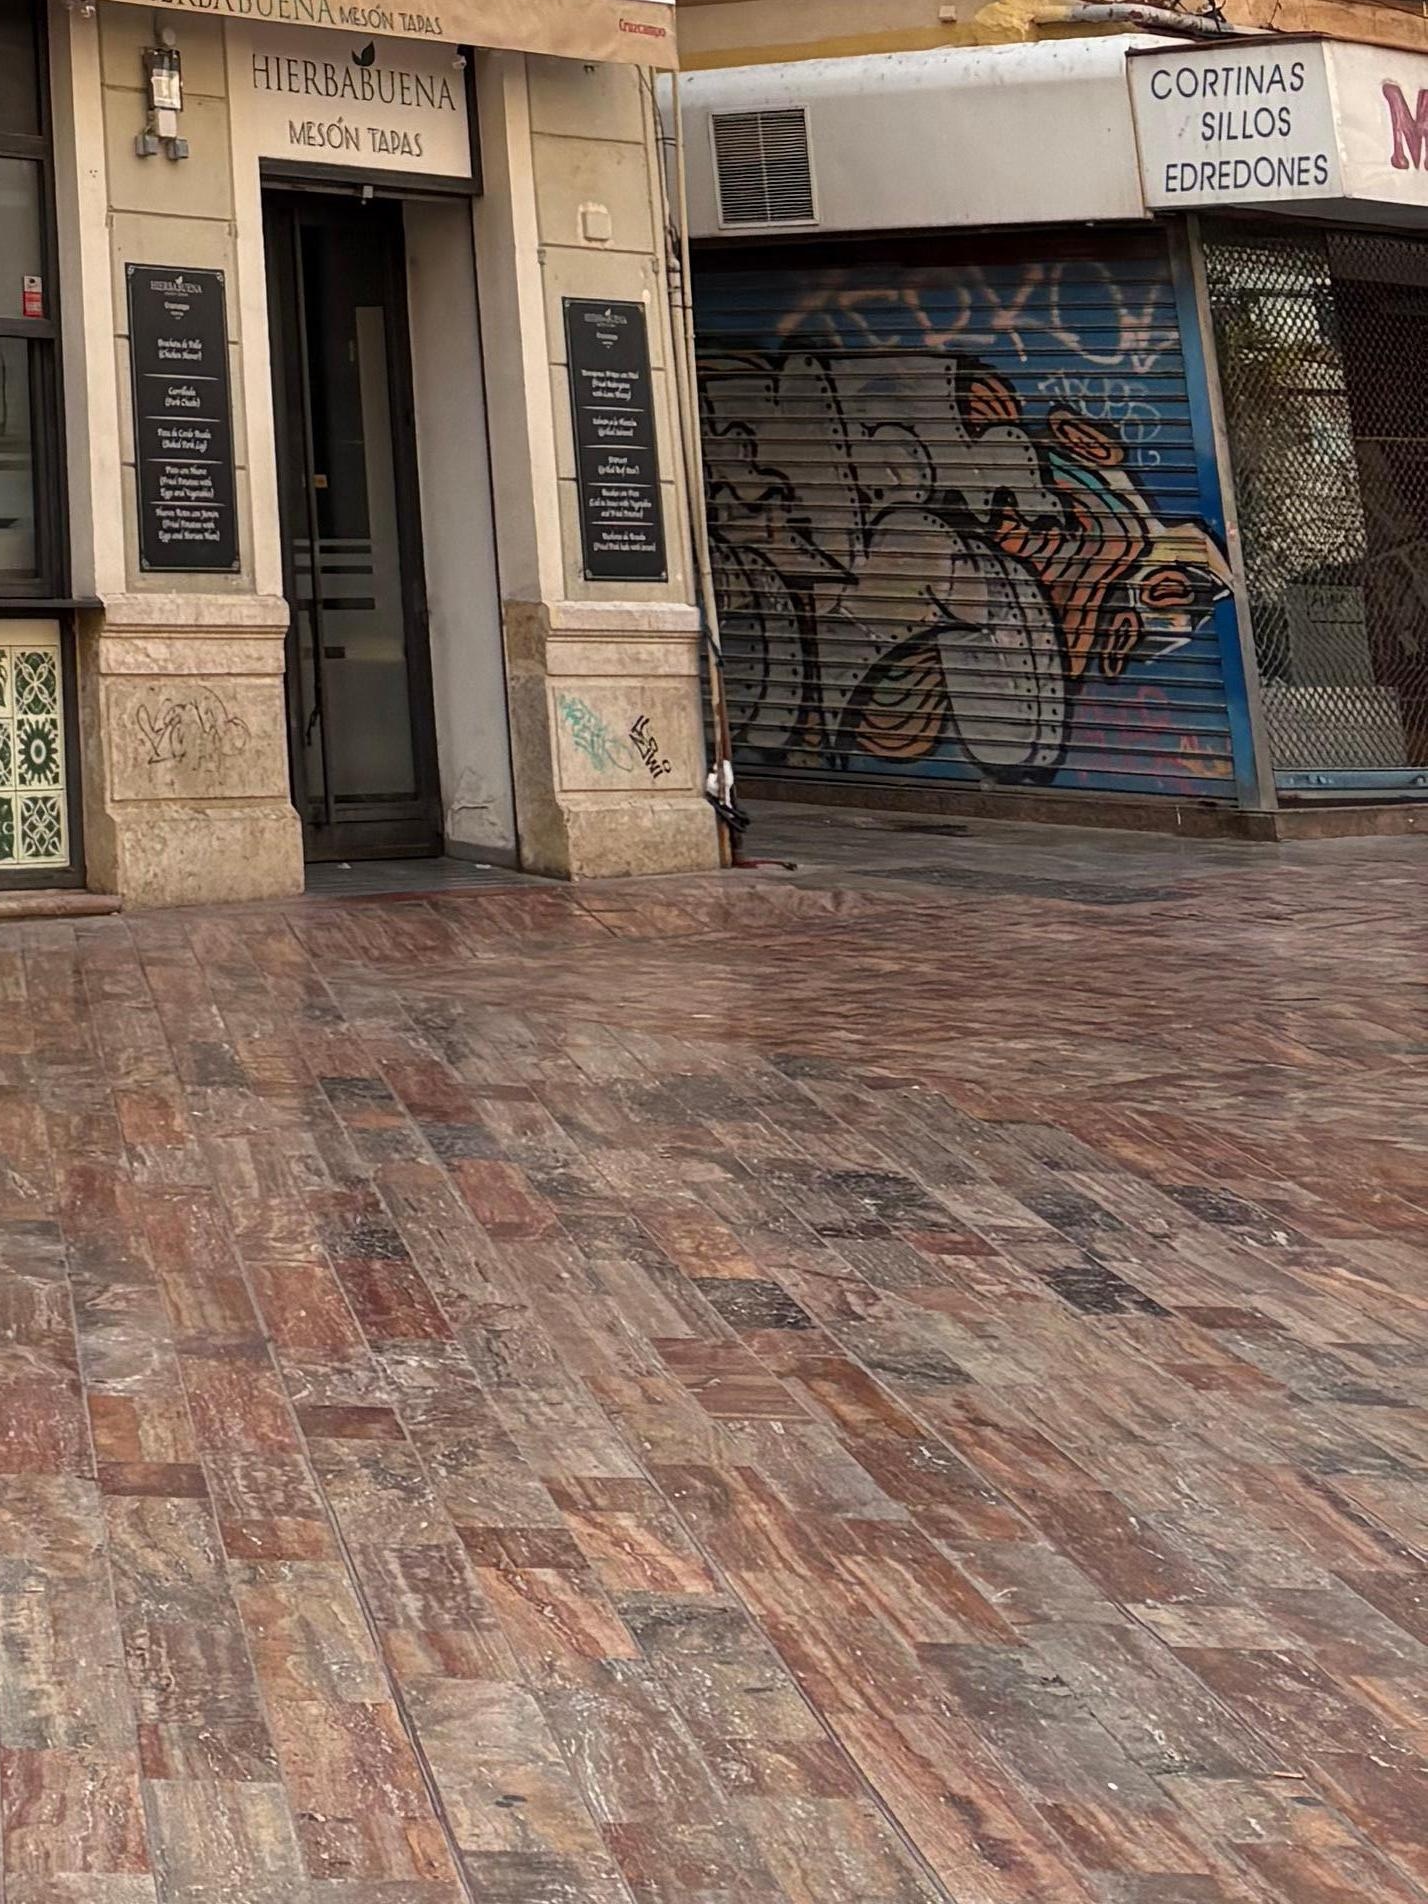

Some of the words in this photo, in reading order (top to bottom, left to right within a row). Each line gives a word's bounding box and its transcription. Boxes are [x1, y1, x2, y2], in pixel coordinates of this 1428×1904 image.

[339, 3, 394, 32] MESÓN
[398, 11, 443, 36] TAPAS
[251, 53, 457, 112] HIERBABUENA
[1150, 62, 1305, 100] CORTINAS
[288, 116, 360, 150] MESÓN
[367, 127, 424, 158] TAPAS
[1201, 106, 1292, 142] SILLOS
[1165, 154, 1329, 193] EDREDONES
